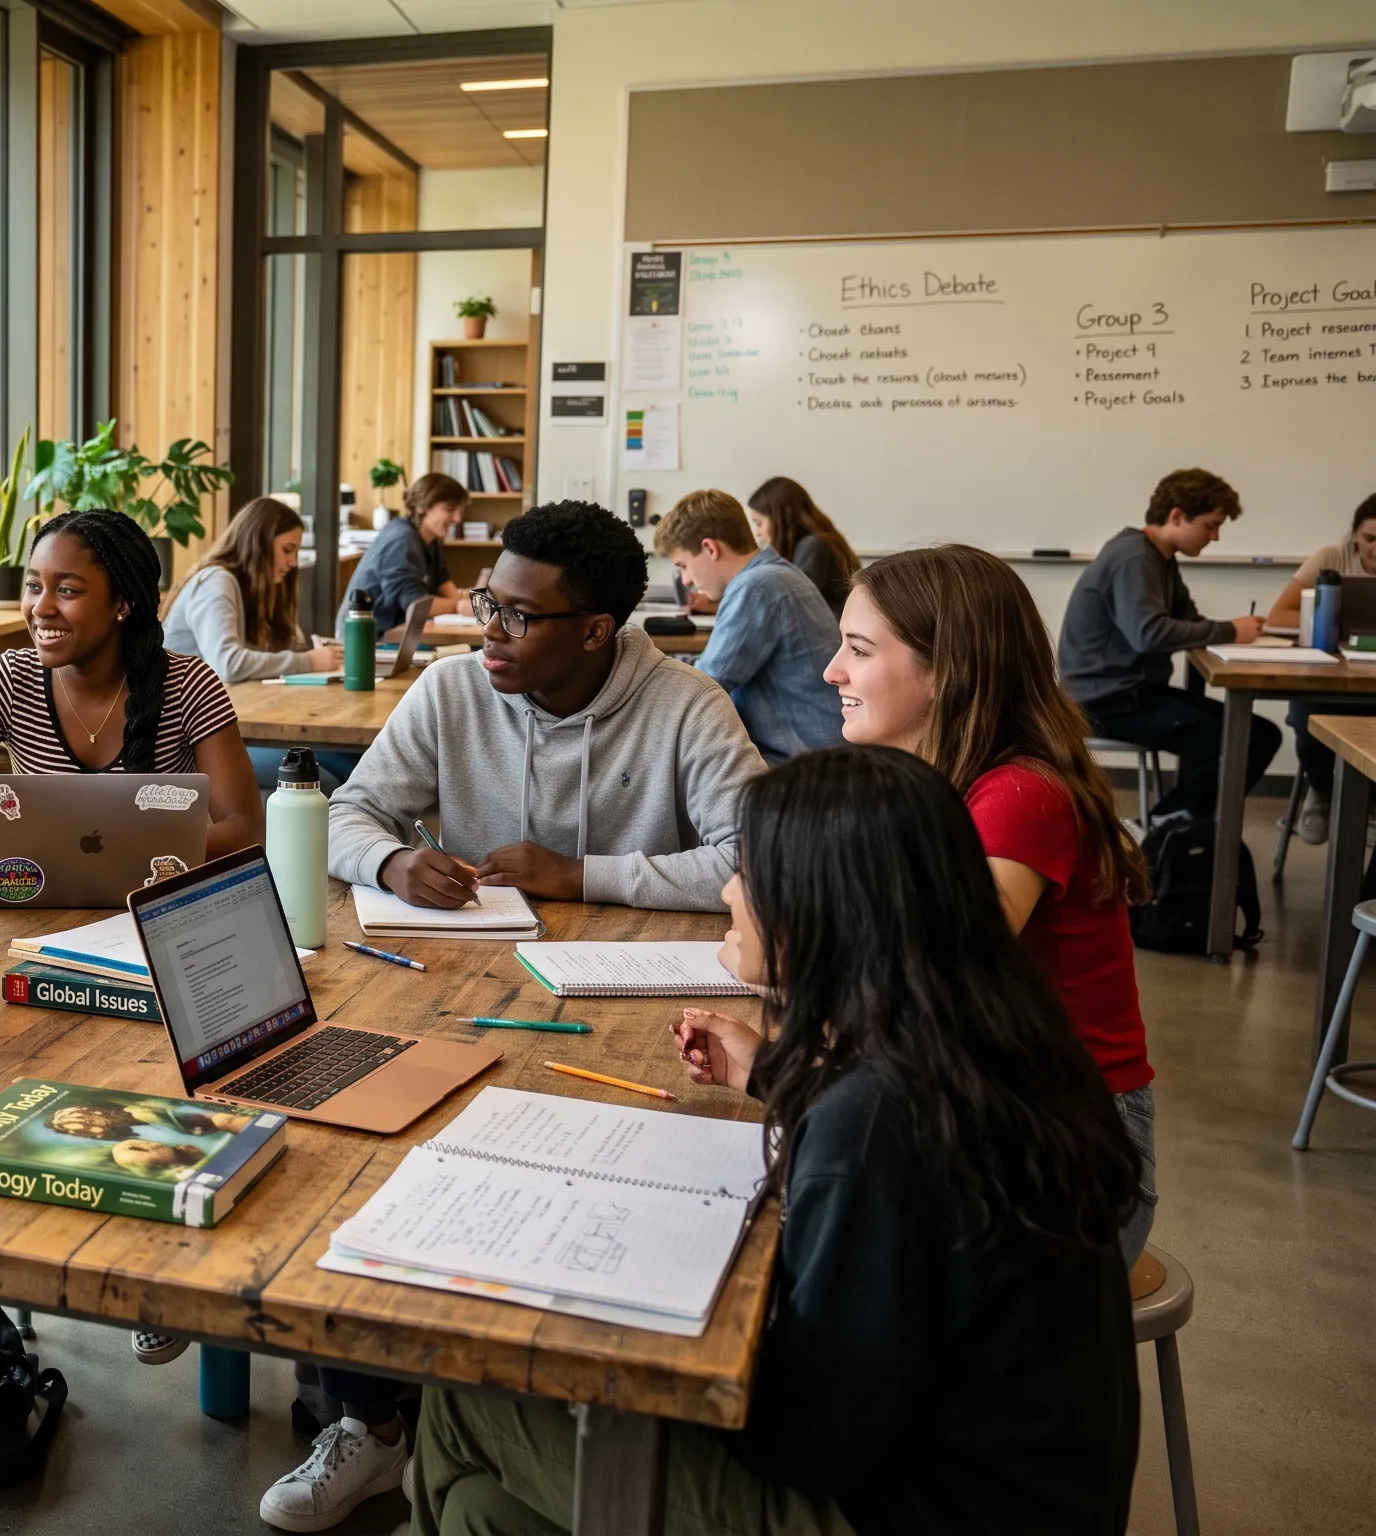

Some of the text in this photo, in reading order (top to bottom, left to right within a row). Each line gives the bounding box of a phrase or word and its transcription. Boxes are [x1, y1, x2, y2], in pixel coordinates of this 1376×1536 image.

[841, 271, 999, 302] Ethics Debate
[1250, 282, 1321, 310] Project
[1076, 302, 1169, 334] Group 3
[1261, 321, 1312, 341] Project
[1086, 343, 1139, 363] Project
[1239, 350, 1251, 364] 2
[1239, 375, 1252, 390] 3
[1325, 371, 1348, 384] the
[1085, 389, 1185, 410] Project Goals
[36, 982, 90, 1006] Global
[95, 989, 148, 1013] Issues
[3, 1084, 58, 1110] Today
[41, 1173, 104, 1207] Today
